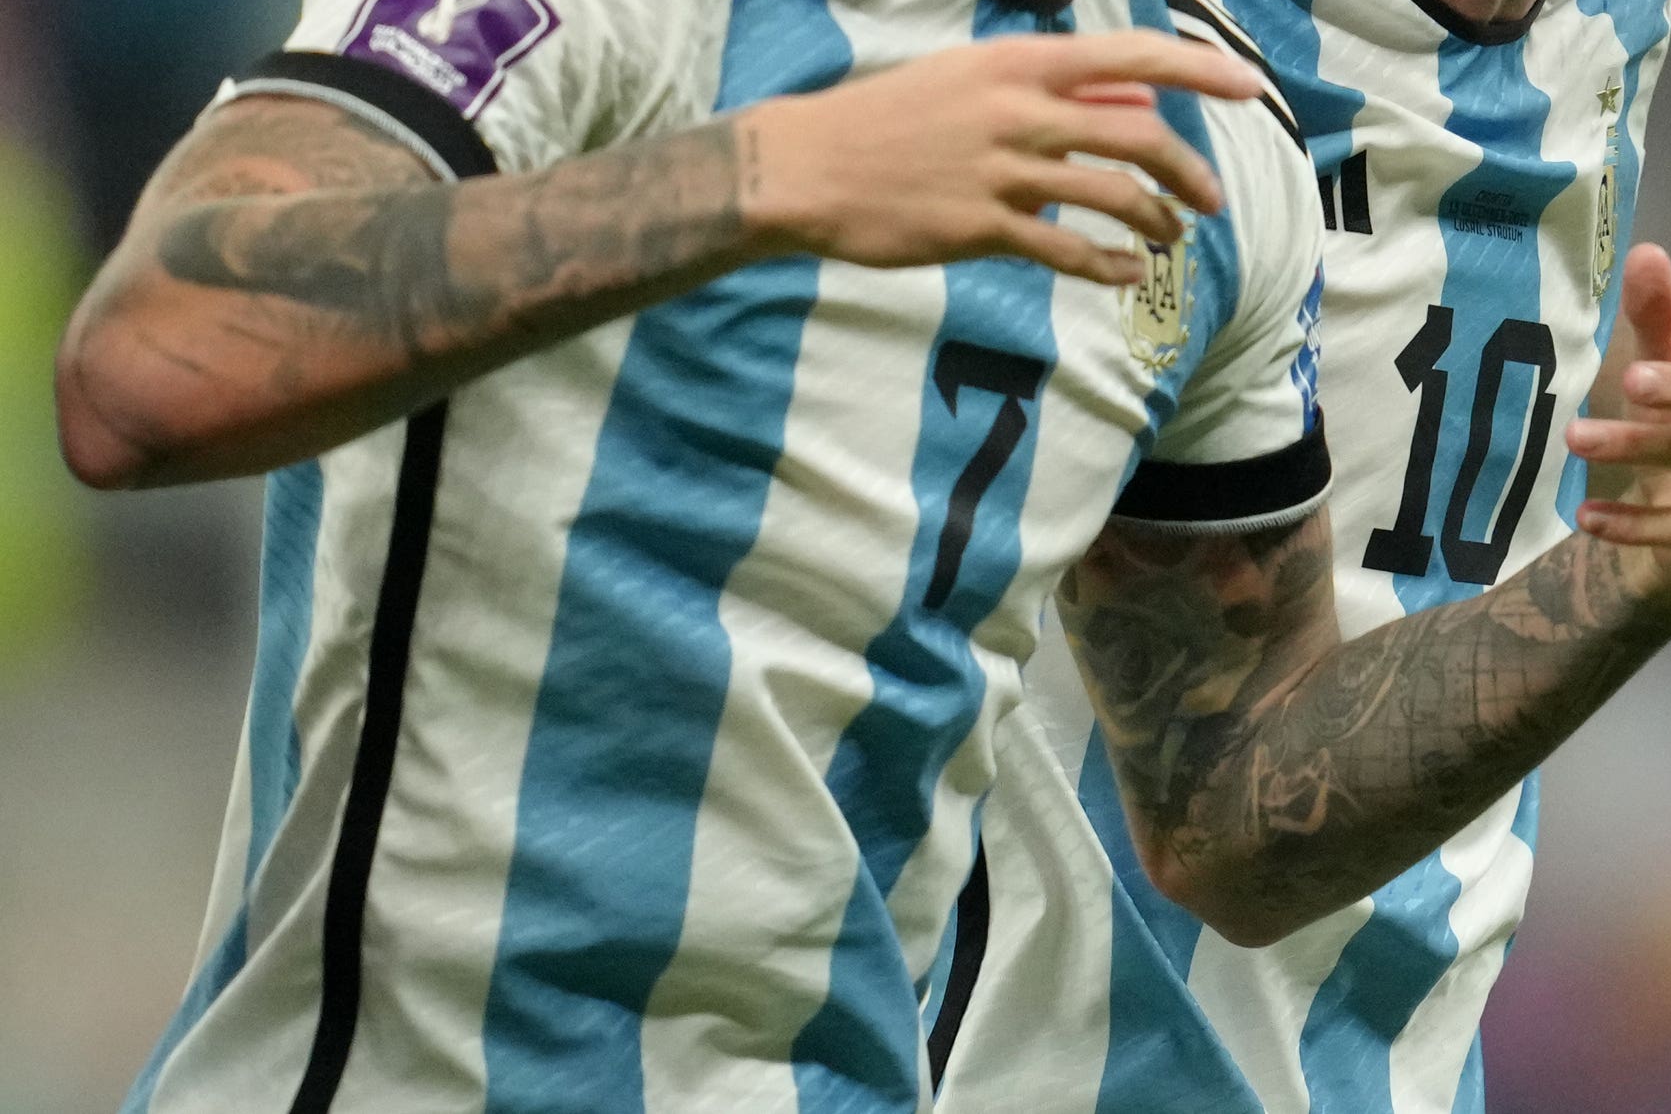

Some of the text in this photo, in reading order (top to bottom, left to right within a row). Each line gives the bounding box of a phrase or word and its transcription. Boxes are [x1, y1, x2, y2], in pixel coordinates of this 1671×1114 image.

[1453, 217, 1524, 244] LUSAIL STADIUM
[921, 339, 1050, 611] 7
[1361, 304, 1557, 586] 10
